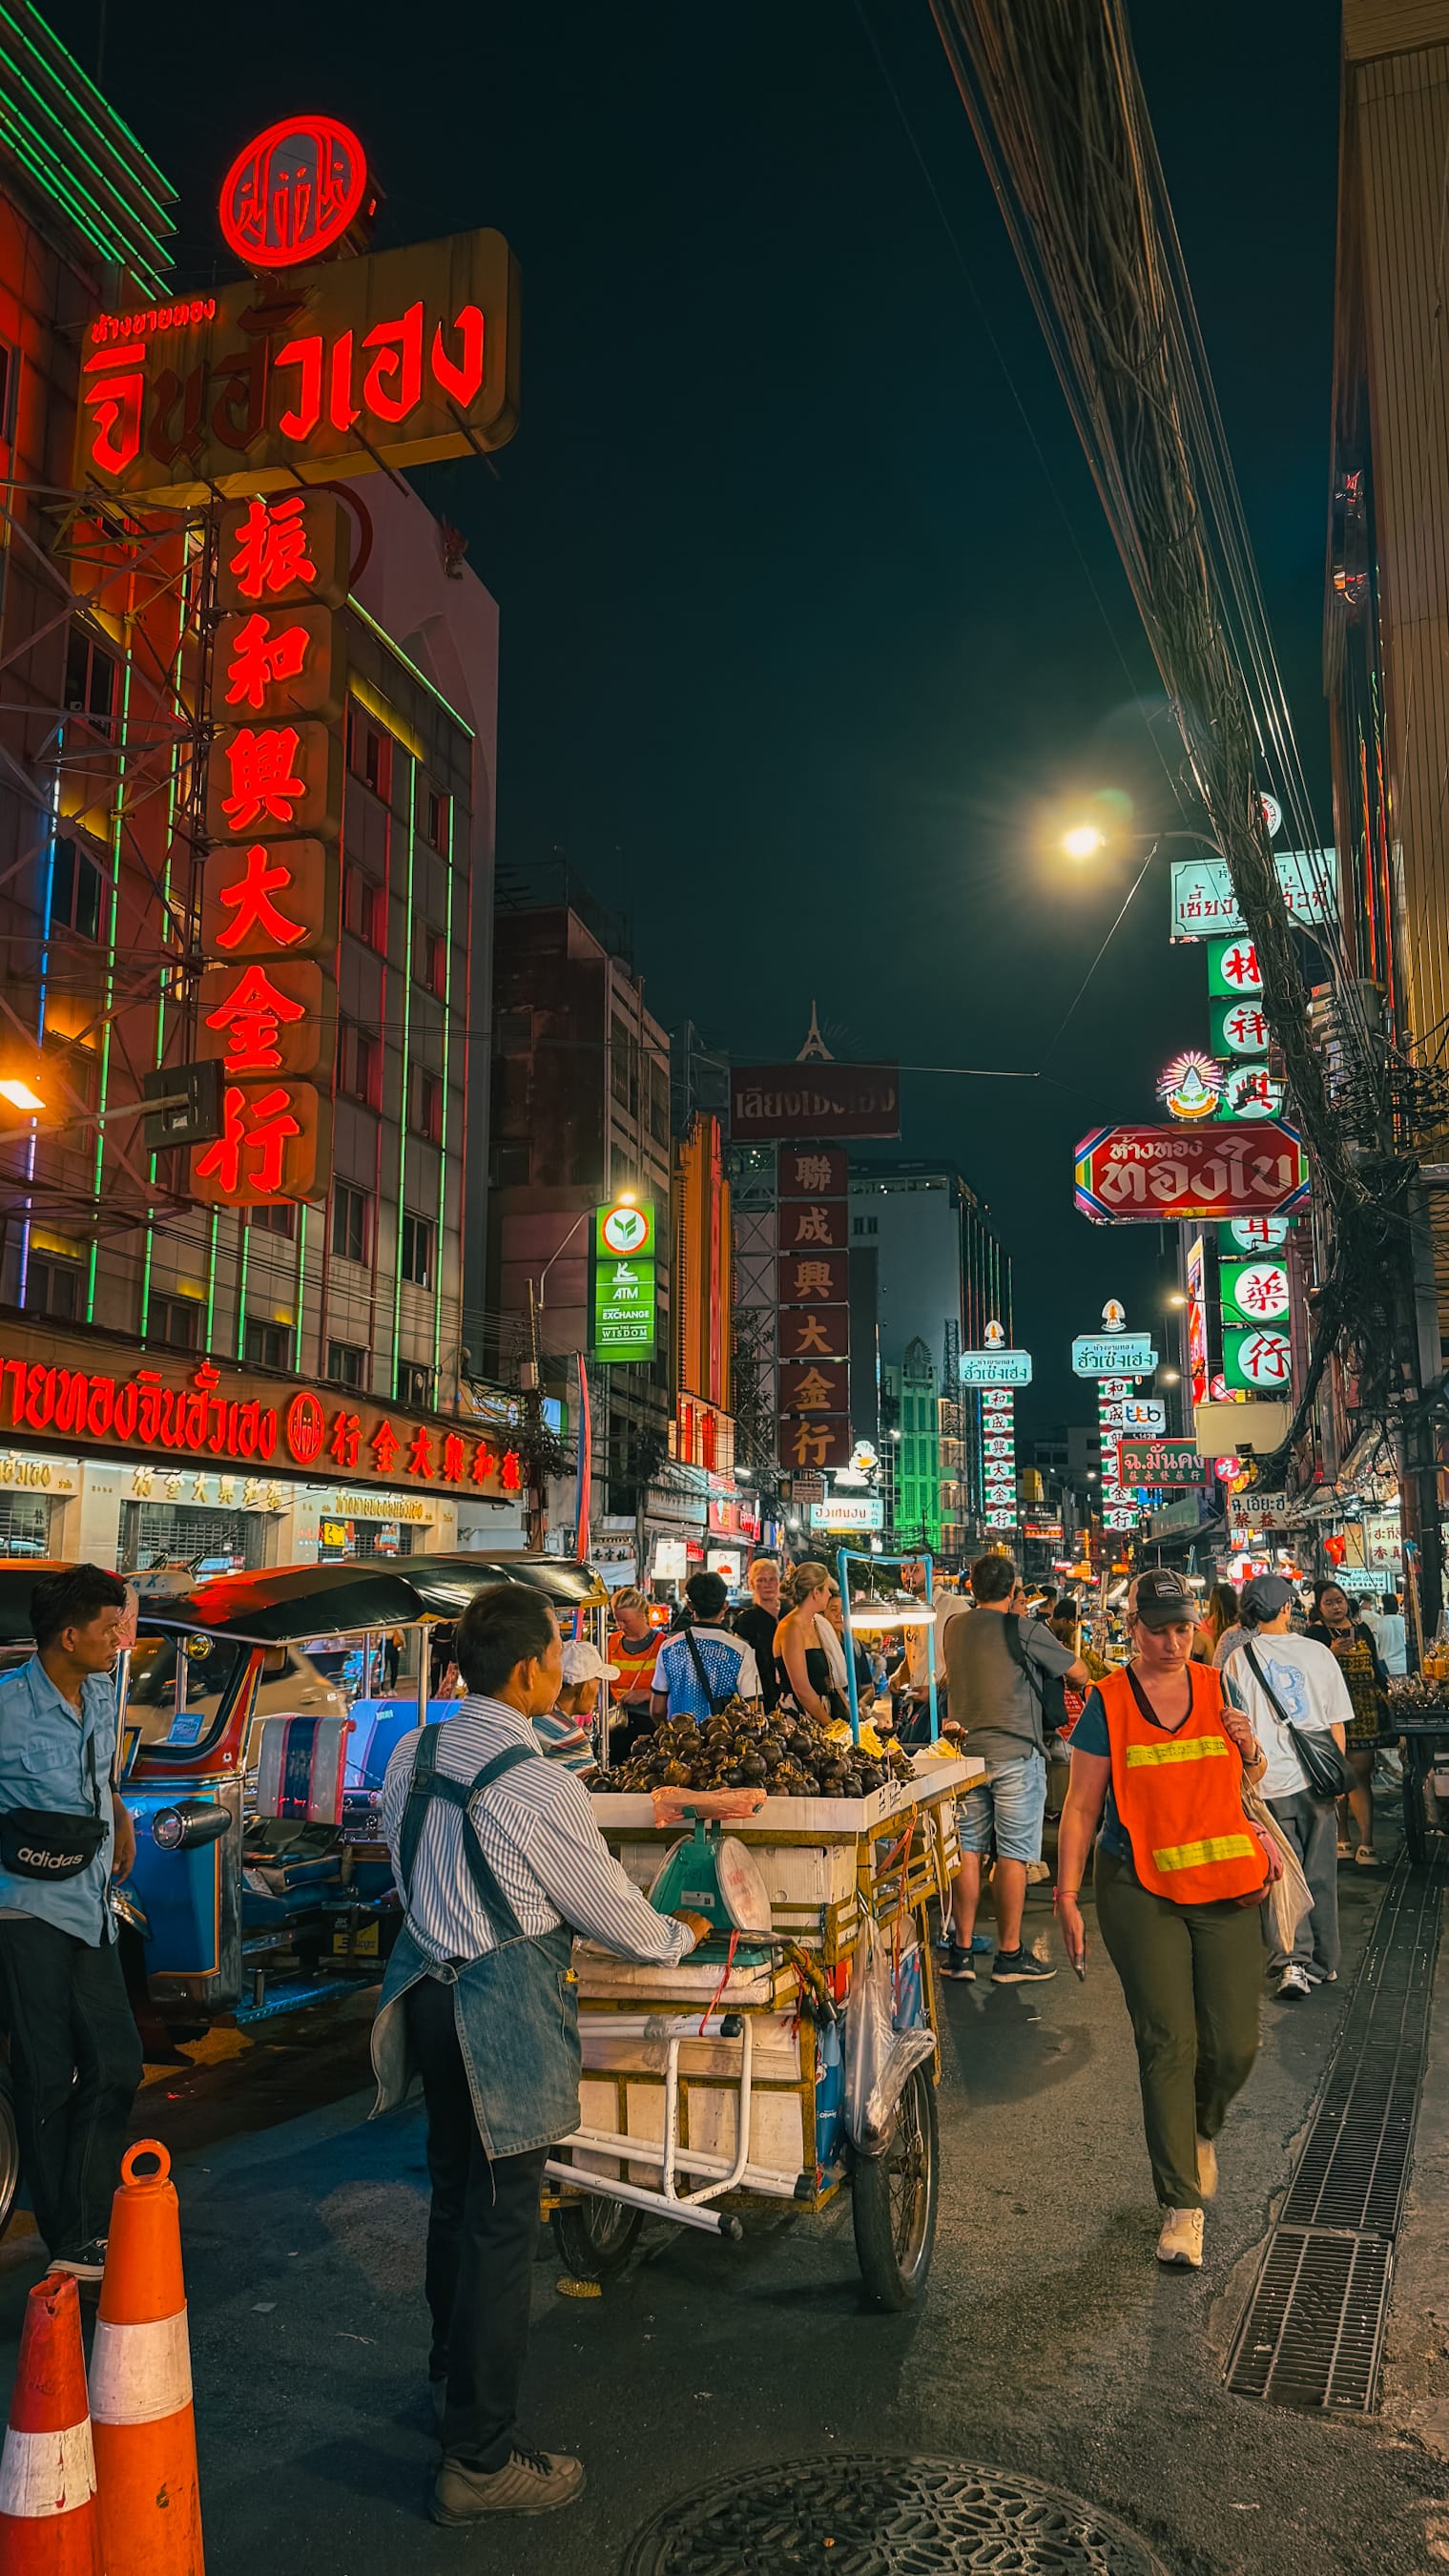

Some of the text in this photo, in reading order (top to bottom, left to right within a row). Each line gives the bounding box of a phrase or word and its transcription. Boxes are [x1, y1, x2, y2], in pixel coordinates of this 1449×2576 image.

[196, 494, 318, 1195] 振和興大金行
[1109, 1136, 1203, 1159] ห้างทอง
[612, 1287, 638, 1299] ATM
[603, 1309, 650, 1320] EXCHANGE
[792, 1154, 836, 1465] 聯成興大金行
[602, 1328, 648, 1338] WISDOM
[1126, 1405, 1161, 1423] ttb
[17, 1847, 84, 1869] adidas
